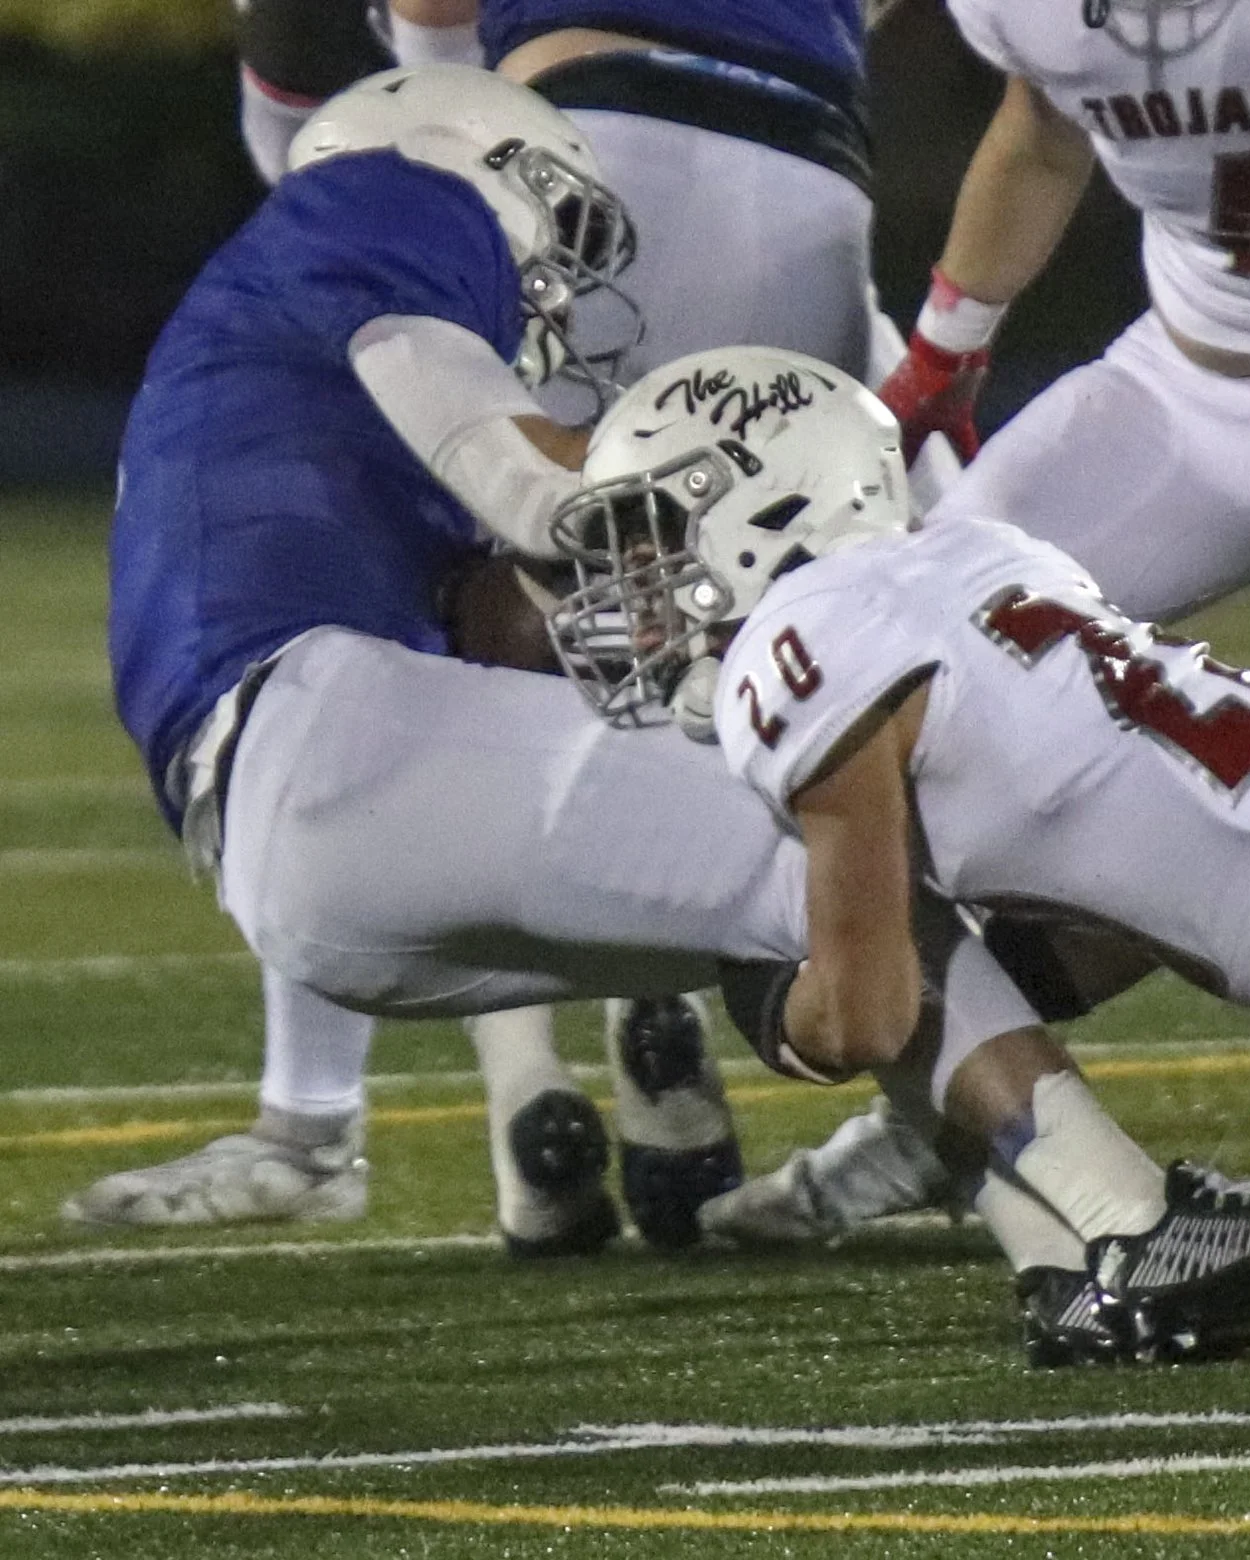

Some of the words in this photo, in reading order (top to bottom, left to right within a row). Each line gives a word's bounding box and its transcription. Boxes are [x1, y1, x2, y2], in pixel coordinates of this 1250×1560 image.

[655, 368, 736, 415] The
[710, 372, 813, 441] Hill
[737, 623, 825, 751] 20
